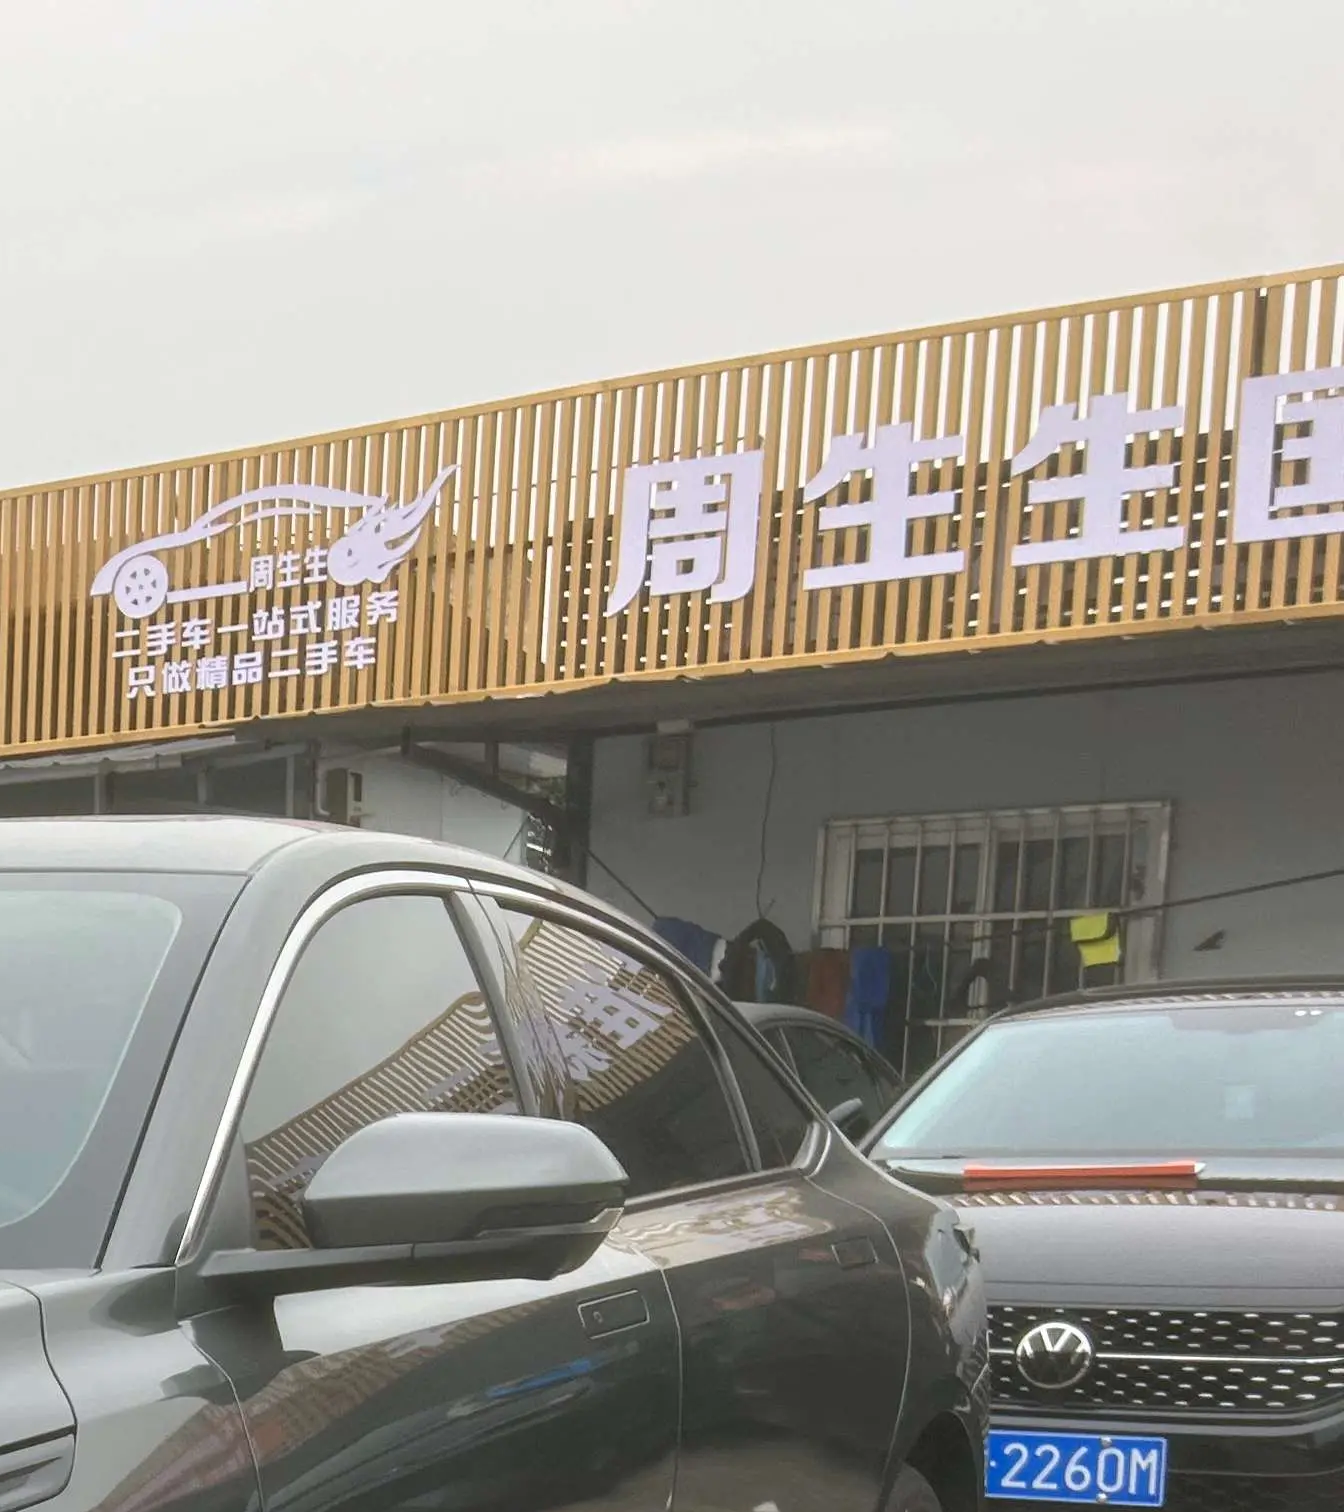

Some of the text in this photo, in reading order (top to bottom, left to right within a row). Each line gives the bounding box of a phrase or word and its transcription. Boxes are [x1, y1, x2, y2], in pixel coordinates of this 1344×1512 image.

[248, 545, 329, 593] 周生生
[112, 590, 400, 657] 二手车一站式服务
[126, 635, 377, 699] 只做精品二手车
